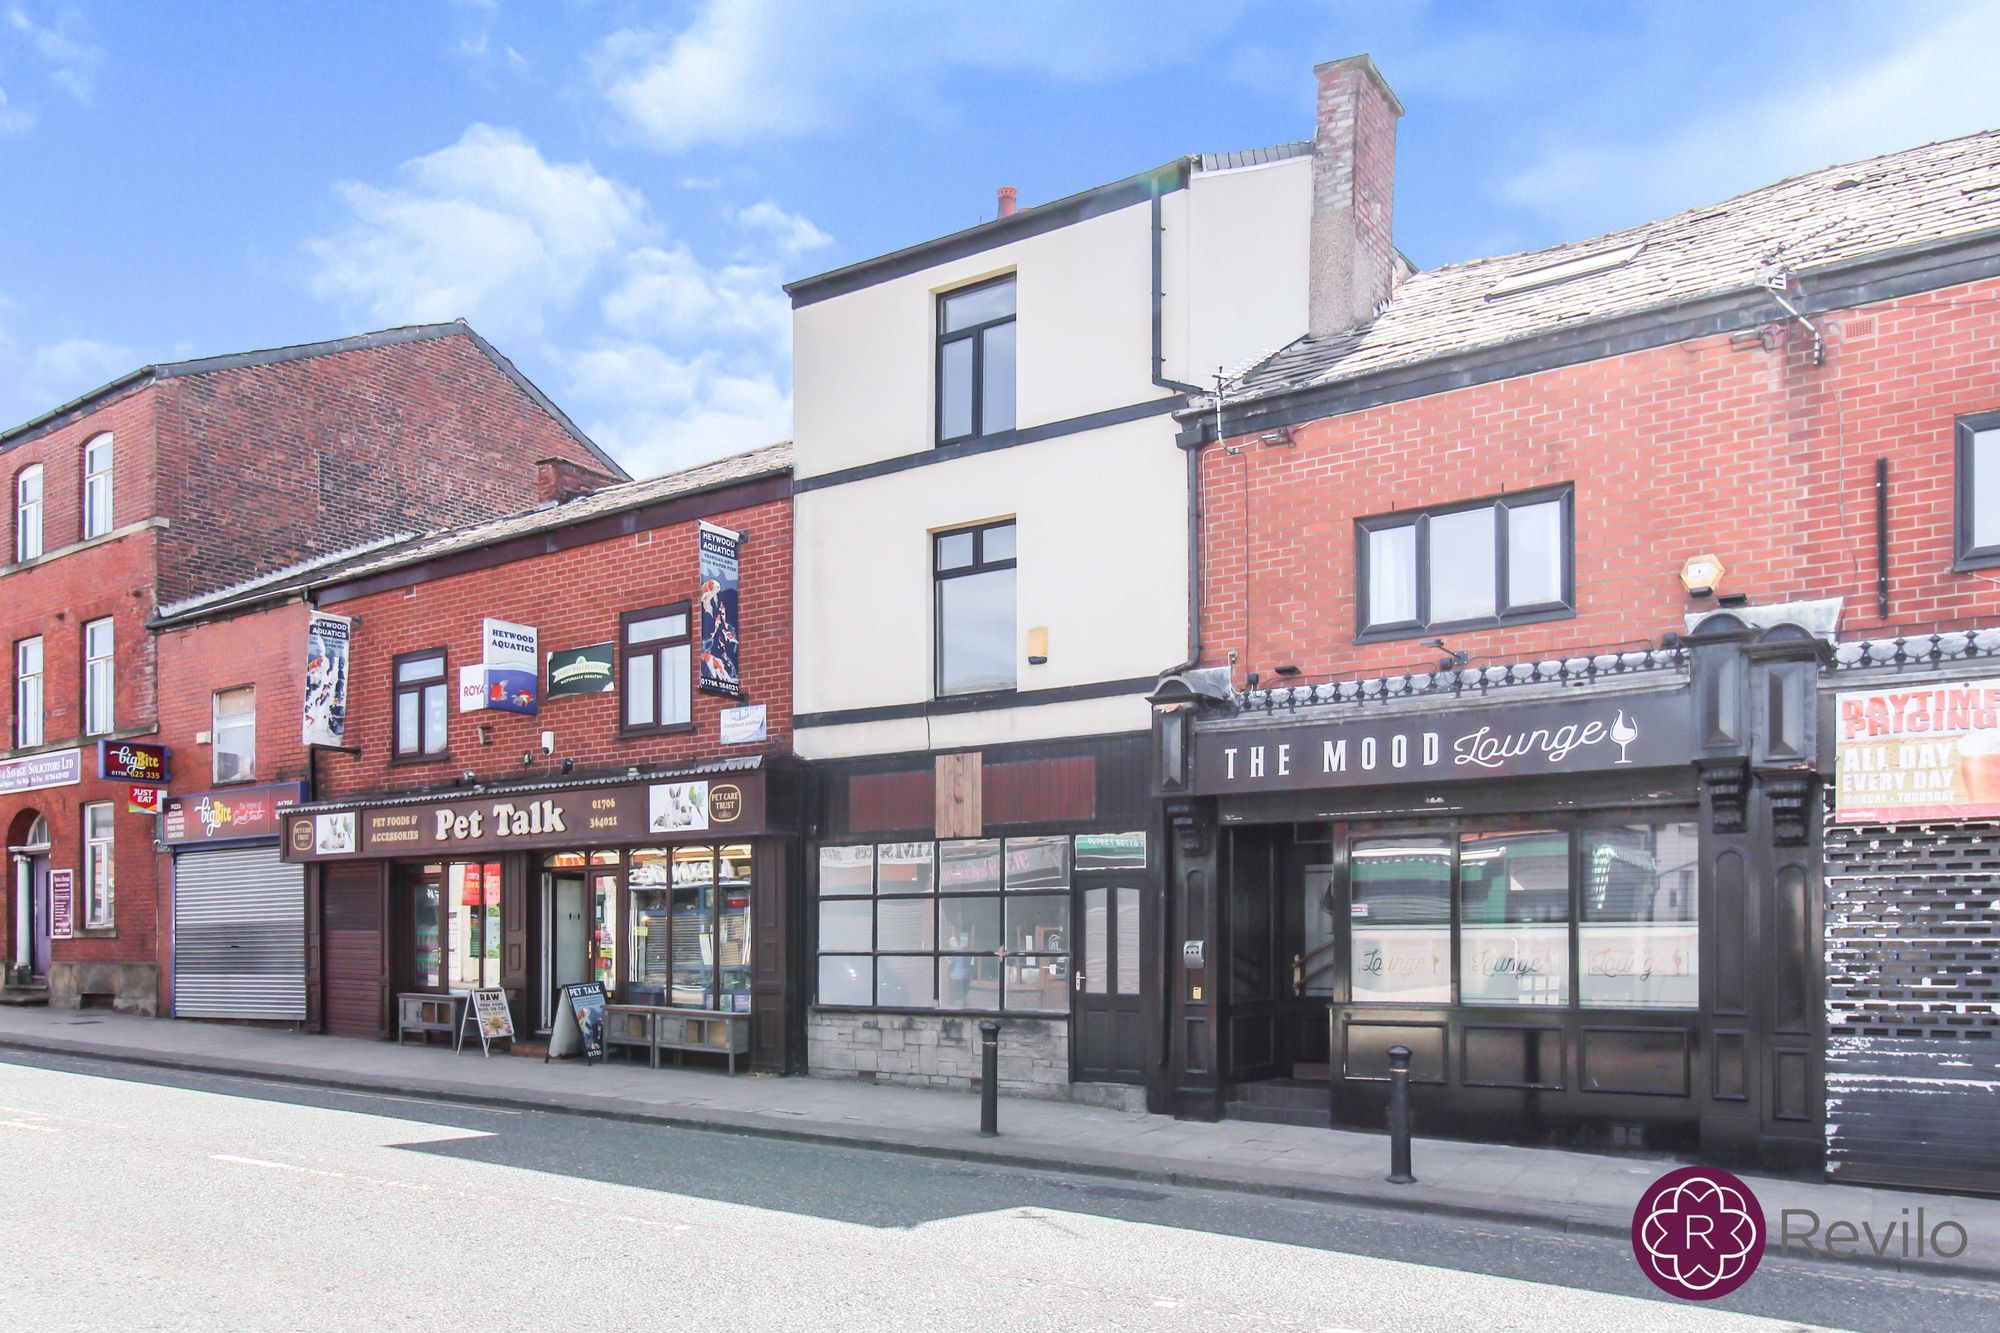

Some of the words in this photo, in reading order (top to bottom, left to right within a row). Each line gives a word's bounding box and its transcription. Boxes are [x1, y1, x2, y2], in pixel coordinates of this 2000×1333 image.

[703, 532, 735, 548] HEYWOOD
[703, 542, 735, 557] AQUATICS
[492, 629, 534, 643] HEYWOOD
[492, 639, 535, 653] AQUATICS
[561, 674, 583, 684] NATURALLY
[1842, 688, 2000, 720] DAYTIME
[1845, 709, 1998, 739] PRICING
[1224, 743, 1290, 779] THE
[1323, 732, 1439, 773] MOOD
[1453, 720, 1607, 768] Lounge
[1843, 747, 1888, 771] ALL
[1900, 743, 1953, 769] DAY
[130, 770, 144, 778] 625
[1842, 771, 1906, 792] EVERY
[1914, 769, 1955, 789] DAY
[133, 789, 154, 797] JUST
[723, 792, 739, 800] CARE
[1842, 793, 1887, 804] MONDAY
[1897, 791, 1955, 803] THURSDAY
[592, 798, 616, 809] 01706
[715, 801, 734, 810] TRUST
[372, 818, 385, 827] PET
[387, 816, 409, 826] FOODS
[435, 809, 484, 841] Pet
[493, 800, 566, 837] Talk
[589, 816, 618, 828] 364021
[371, 830, 419, 842] ACCESSORIES
[569, 988, 582, 996] PET
[583, 985, 601, 994] TALK
[480, 993, 500, 1001] RAW
